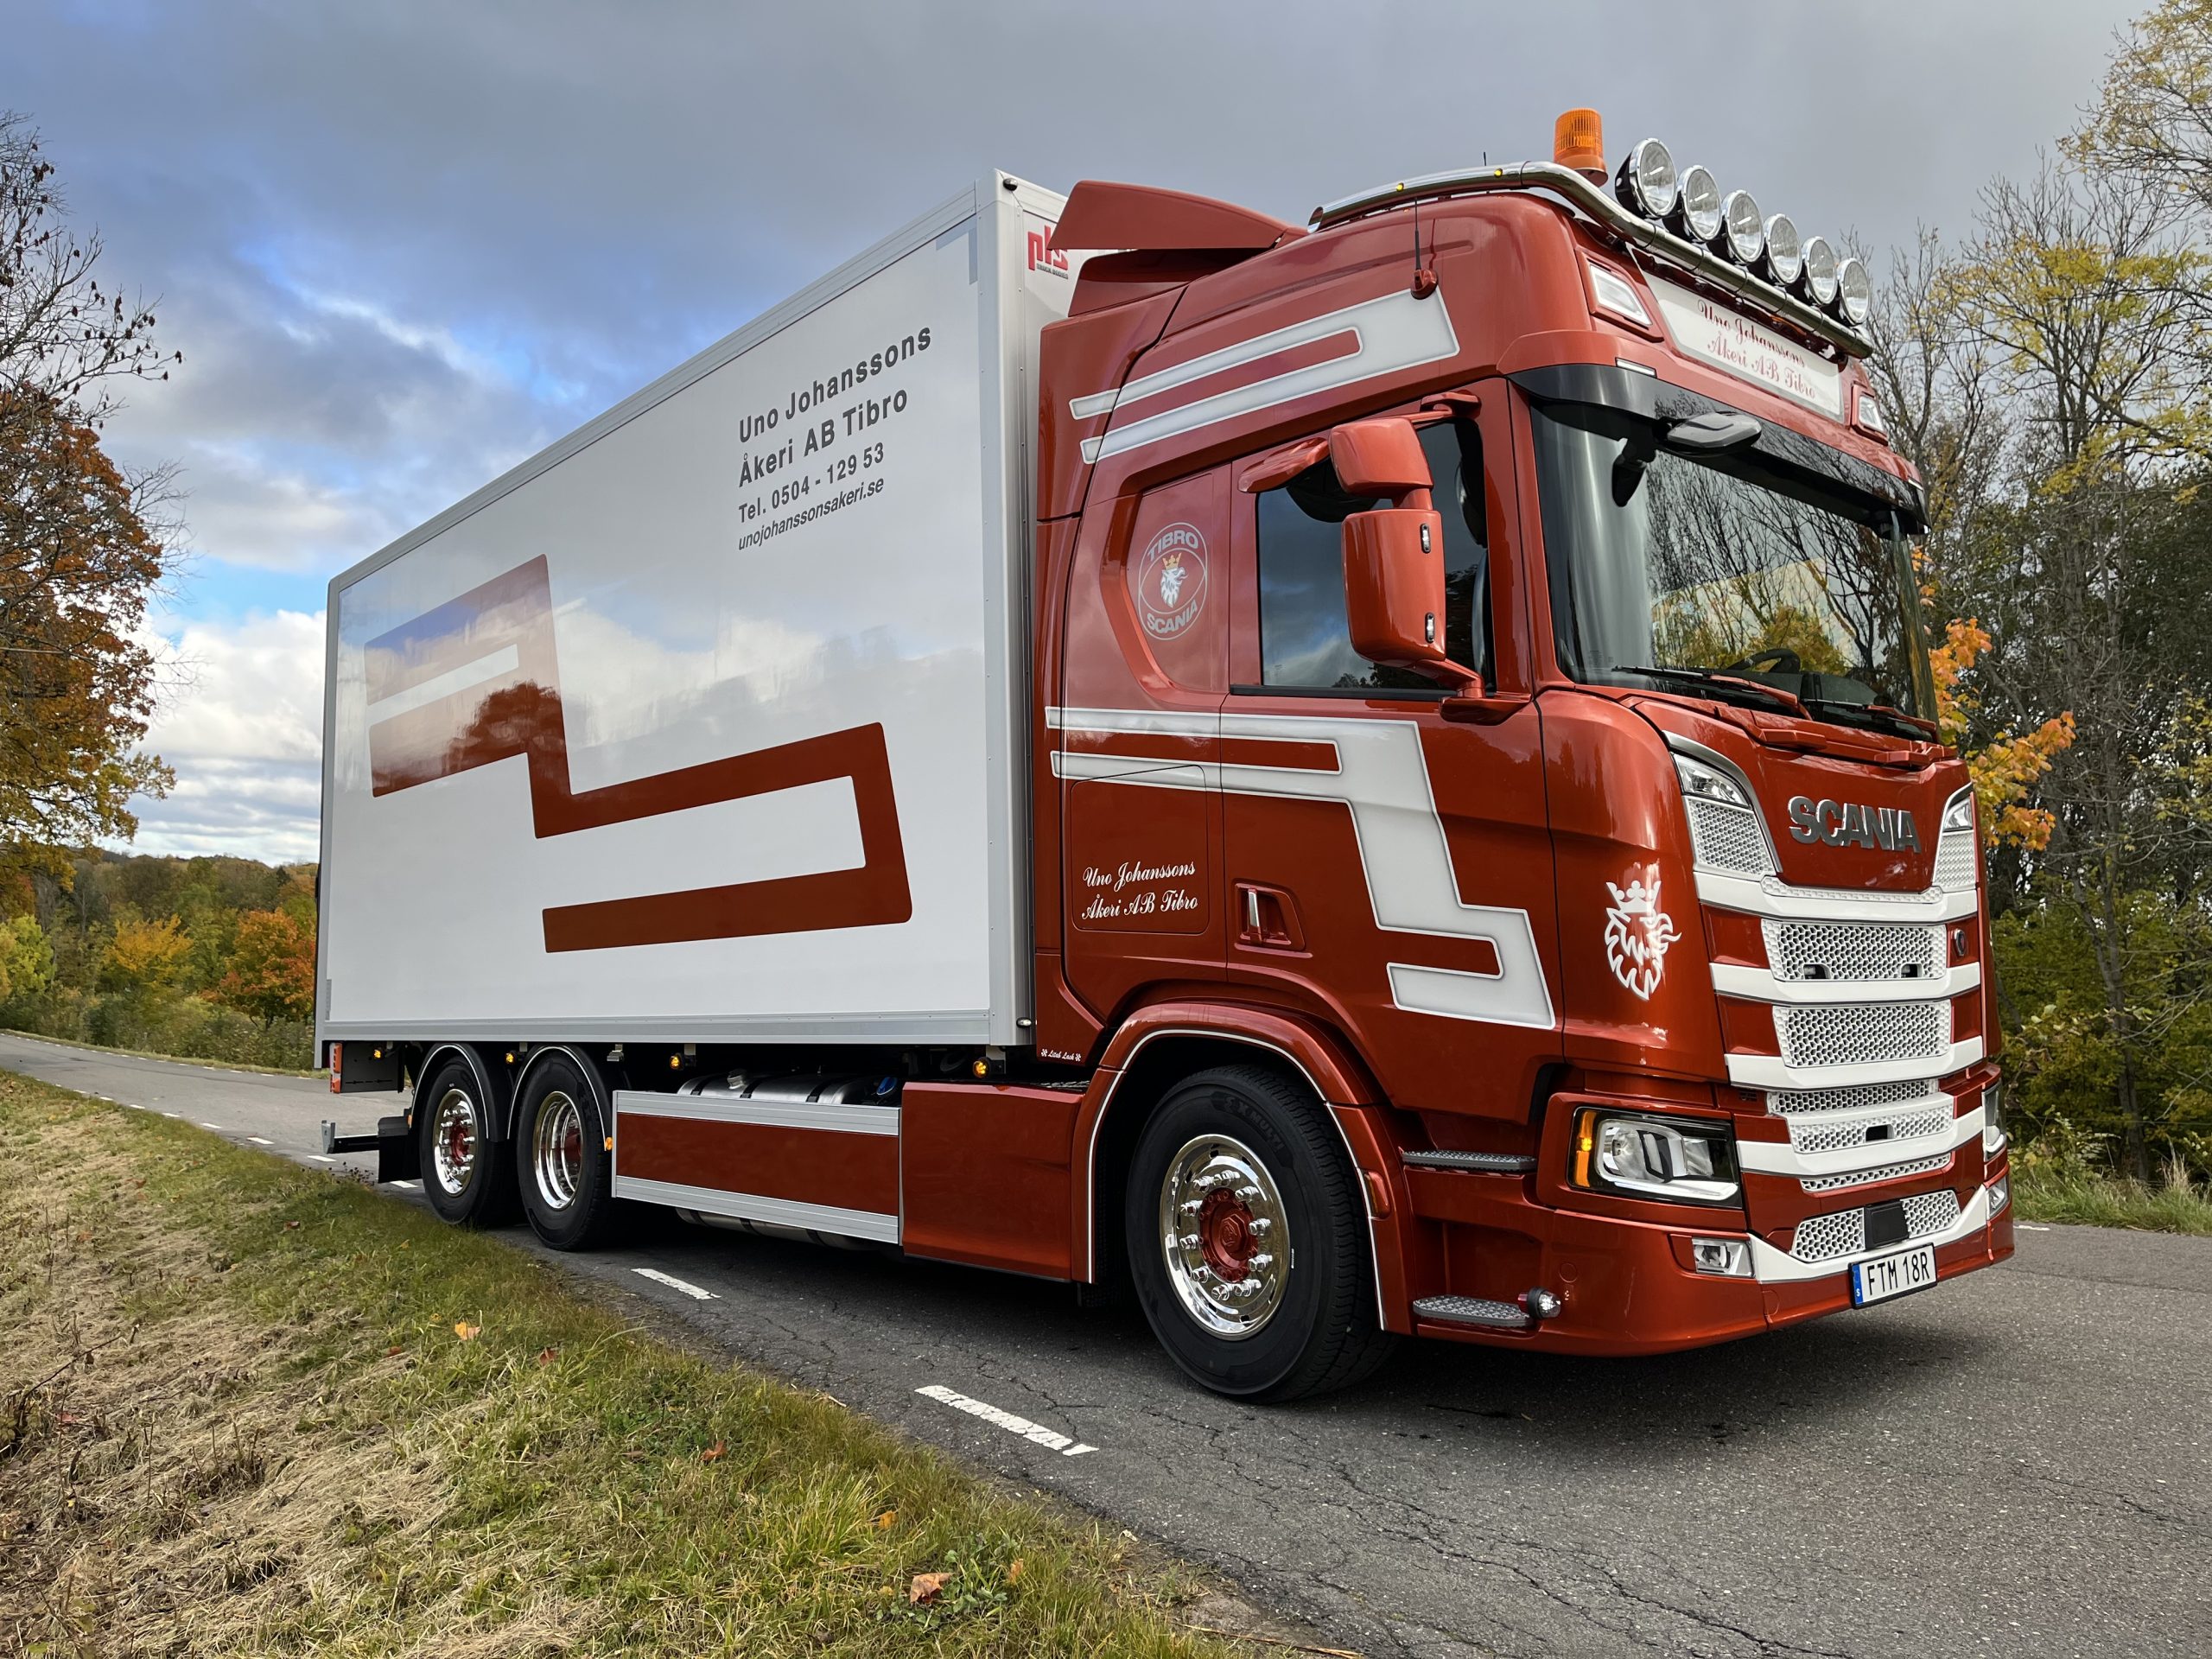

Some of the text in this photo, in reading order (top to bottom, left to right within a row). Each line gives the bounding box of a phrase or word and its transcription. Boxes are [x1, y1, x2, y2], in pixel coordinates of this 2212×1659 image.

[1698, 299, 1805, 367] Uno Johanssons
[739, 327, 931, 443] Uno Johanssons
[1707, 330, 1815, 398] Åkeri AB Tibro
[739, 389, 907, 487] Åkeri AB Tibro
[739, 497, 766, 524] Tel.
[772, 475, 810, 509] 0504
[827, 454, 857, 484] 129
[863, 442, 884, 468] 53
[739, 477, 884, 551] unojohanssonsakeri.se
[1147, 530, 1198, 562] TIBRO
[1147, 599, 1198, 633] SCANIA
[1788, 796, 1922, 854] SCANIA
[1082, 861, 1196, 893] Uno Johanssons
[1081, 889, 1198, 920] Åkeri AB Tibro
[1250, 1109, 1286, 1151] MULTI
[1856, 1288, 1860, 1297] S
[1867, 1251, 1930, 1295] FTM 18R
